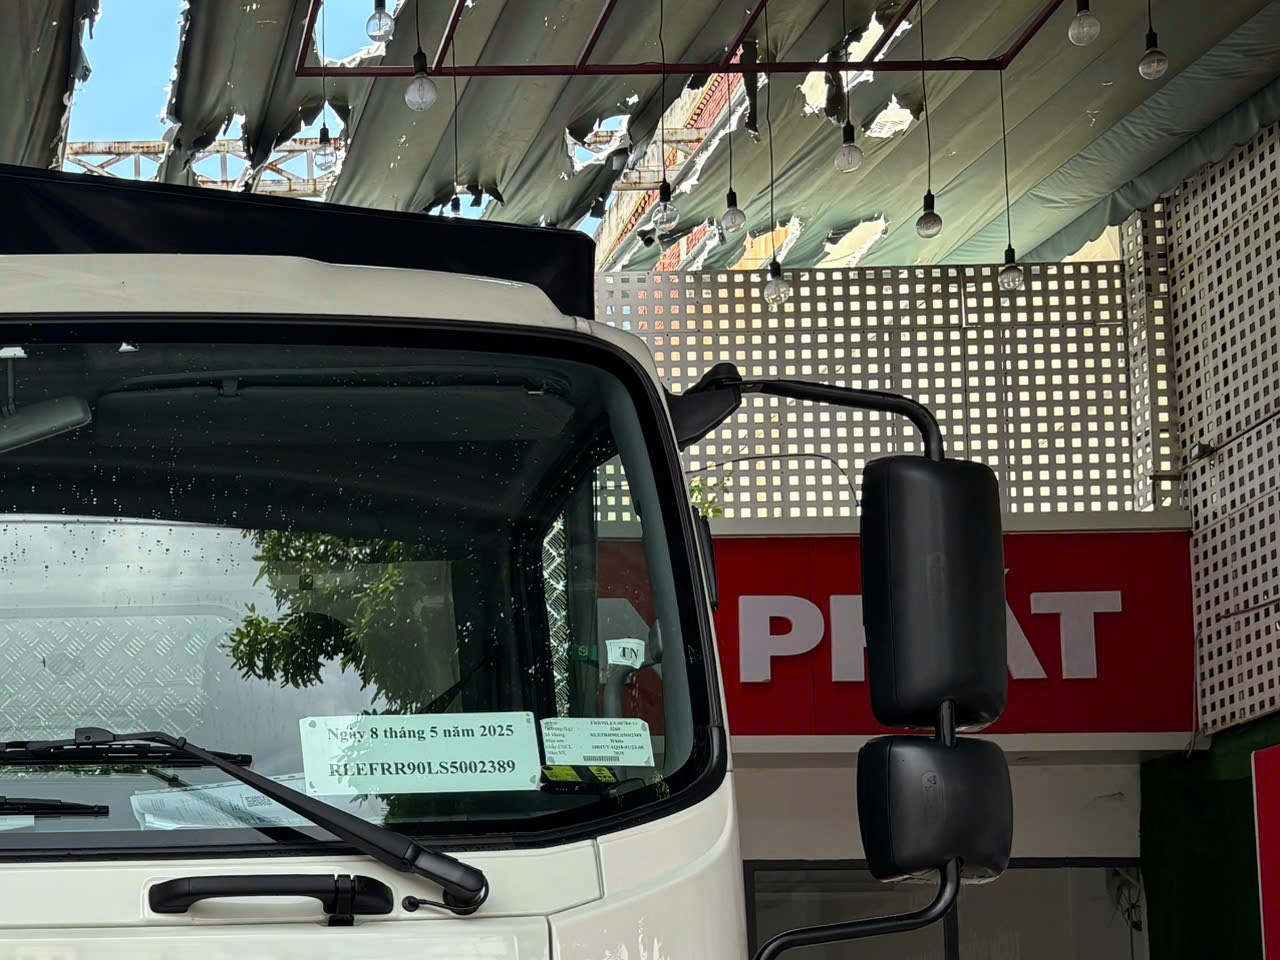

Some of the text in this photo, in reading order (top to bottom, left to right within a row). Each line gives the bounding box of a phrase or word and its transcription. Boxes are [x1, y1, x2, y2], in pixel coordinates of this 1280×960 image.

[738, 568, 1122, 684] PT
[619, 646, 638, 660] TN
[327, 724, 514, 743] Ngày 8 tháng 5 năm 2025
[327, 759, 516, 777] RLEFRR90LS5002389
